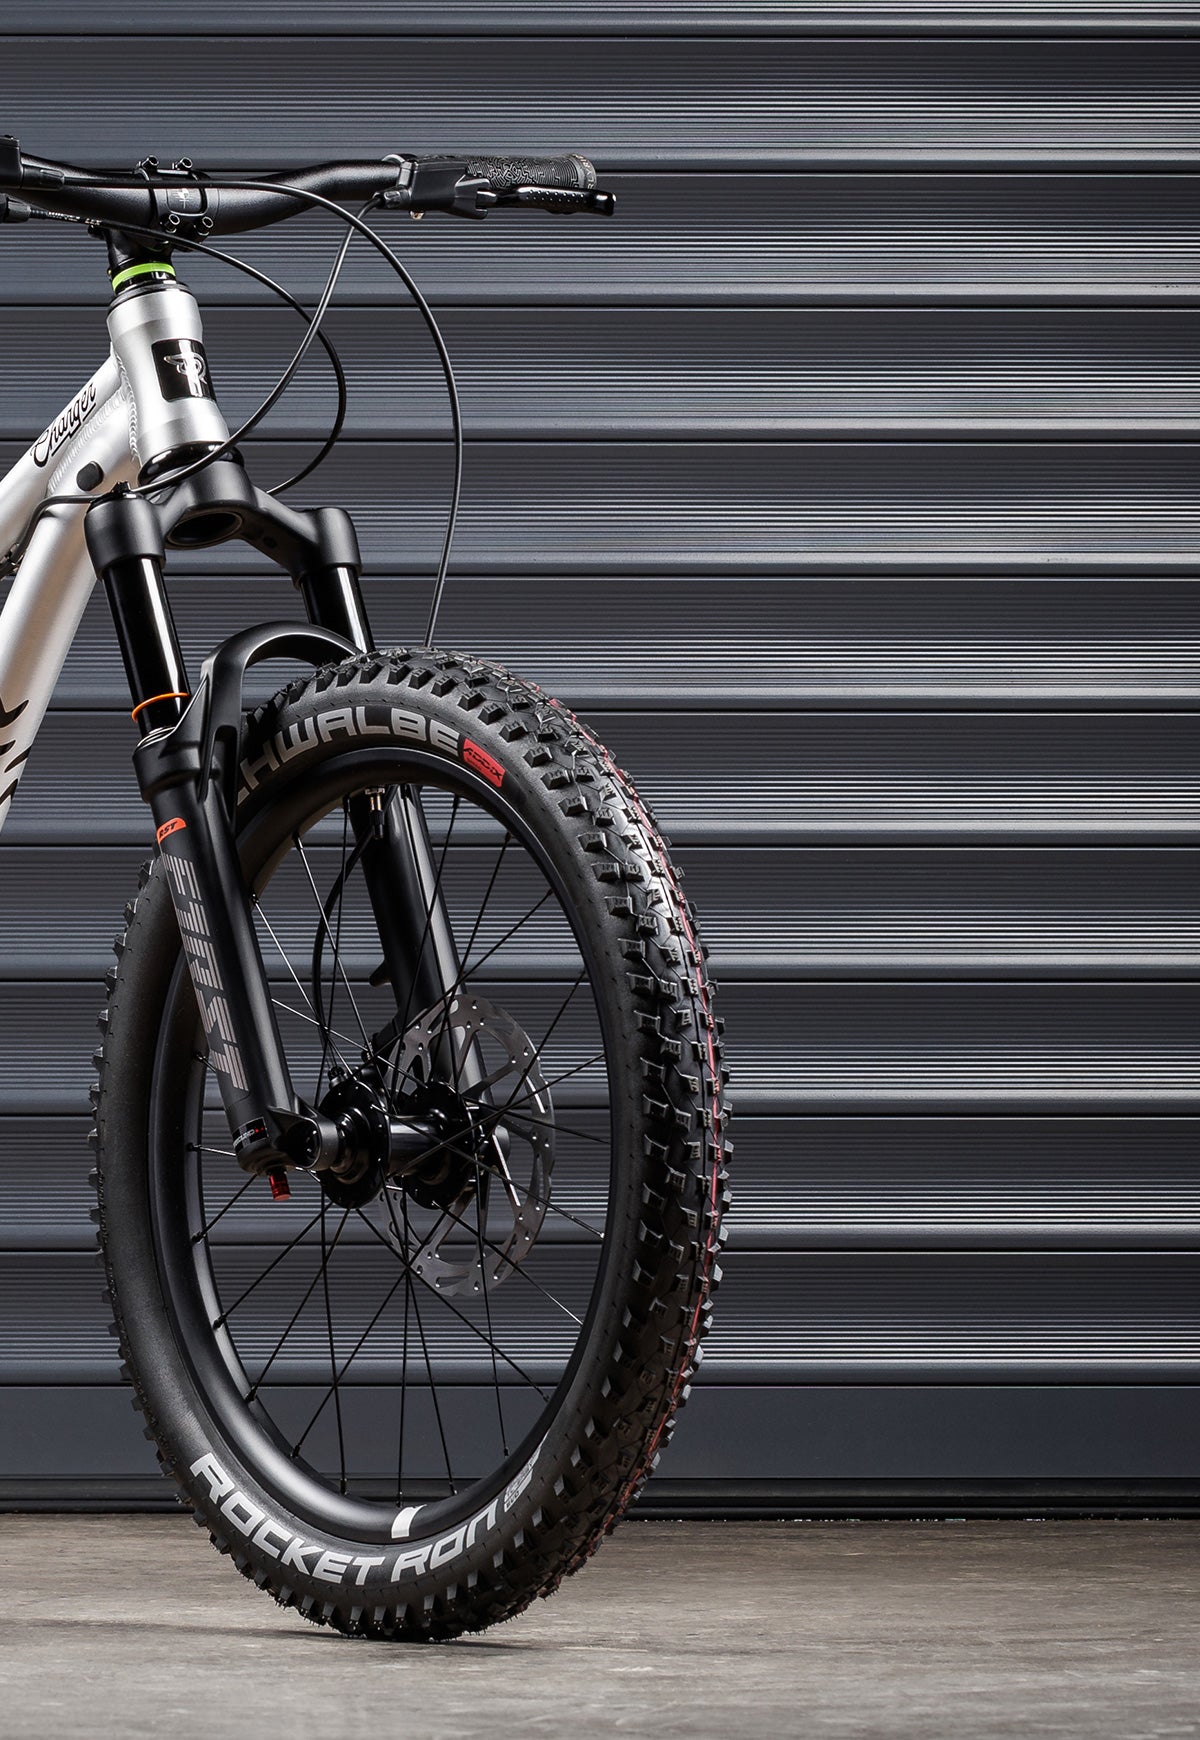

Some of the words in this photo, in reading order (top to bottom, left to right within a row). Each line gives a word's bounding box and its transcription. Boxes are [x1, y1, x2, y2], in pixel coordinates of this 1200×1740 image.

[30, 382, 97, 468] Charger
[237, 706, 461, 806] HWALBE
[190, 1452, 386, 1586] ROCKET
[391, 1498, 499, 1583] RON
